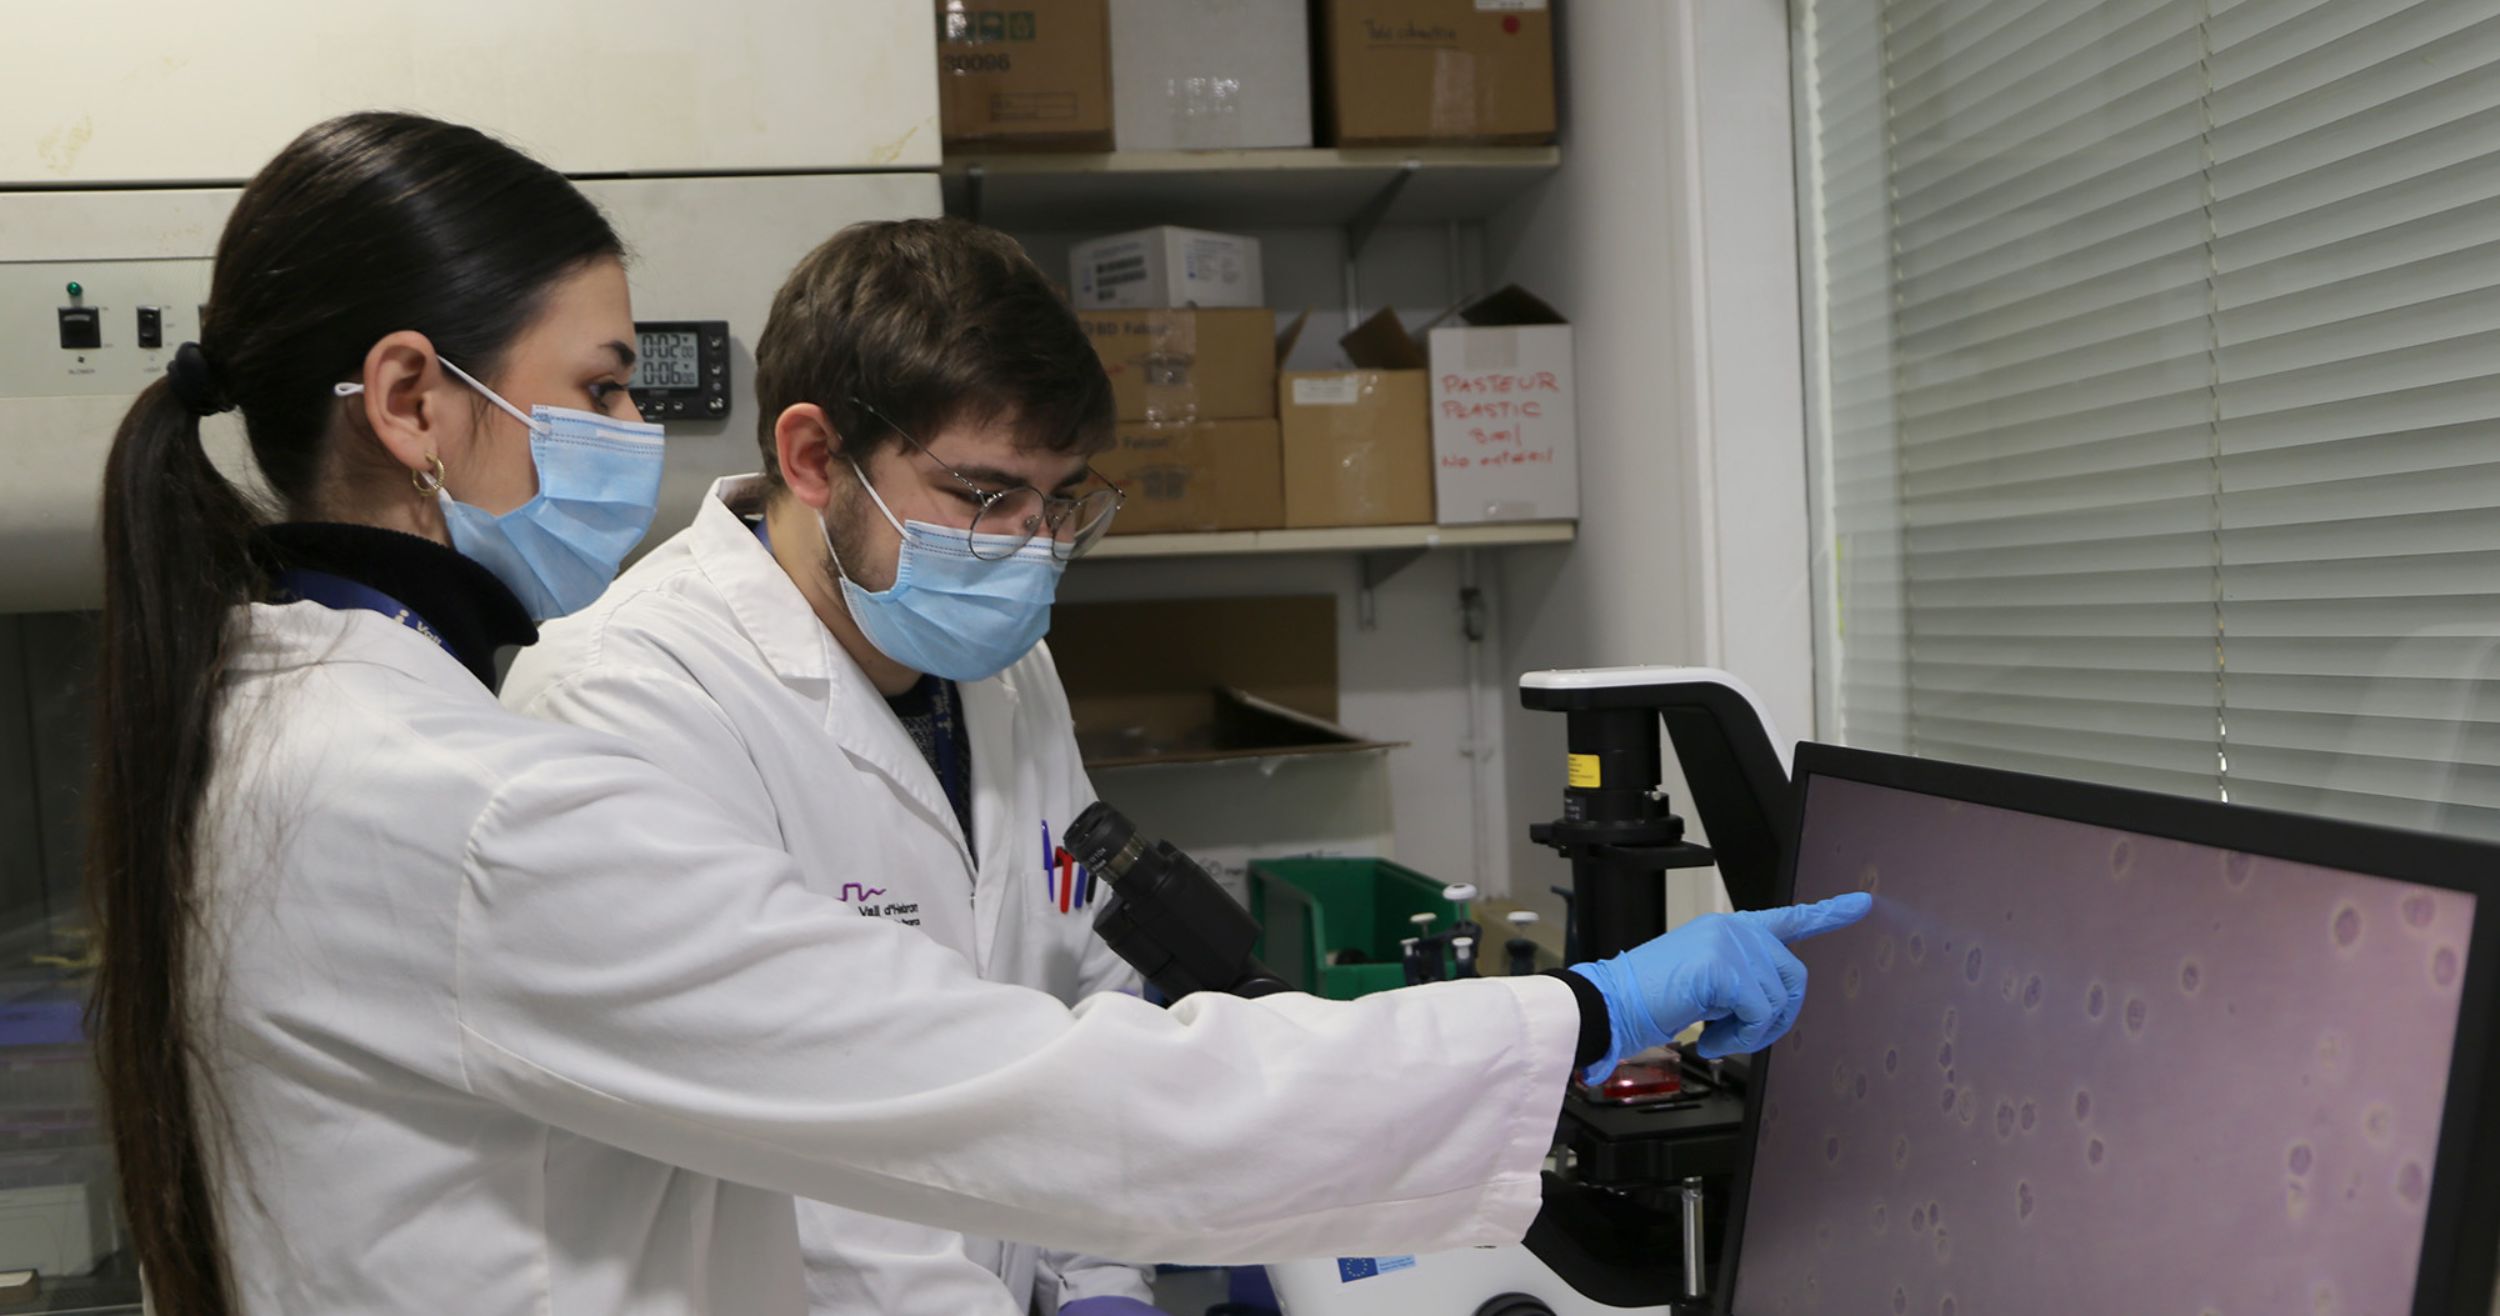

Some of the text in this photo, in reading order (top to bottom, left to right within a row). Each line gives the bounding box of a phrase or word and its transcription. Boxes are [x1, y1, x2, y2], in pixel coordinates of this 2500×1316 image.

[1442, 371, 1560, 393] PASTEUR
[1442, 400, 1541, 419] PLASTIC
[858, 905, 880, 916] Vall
